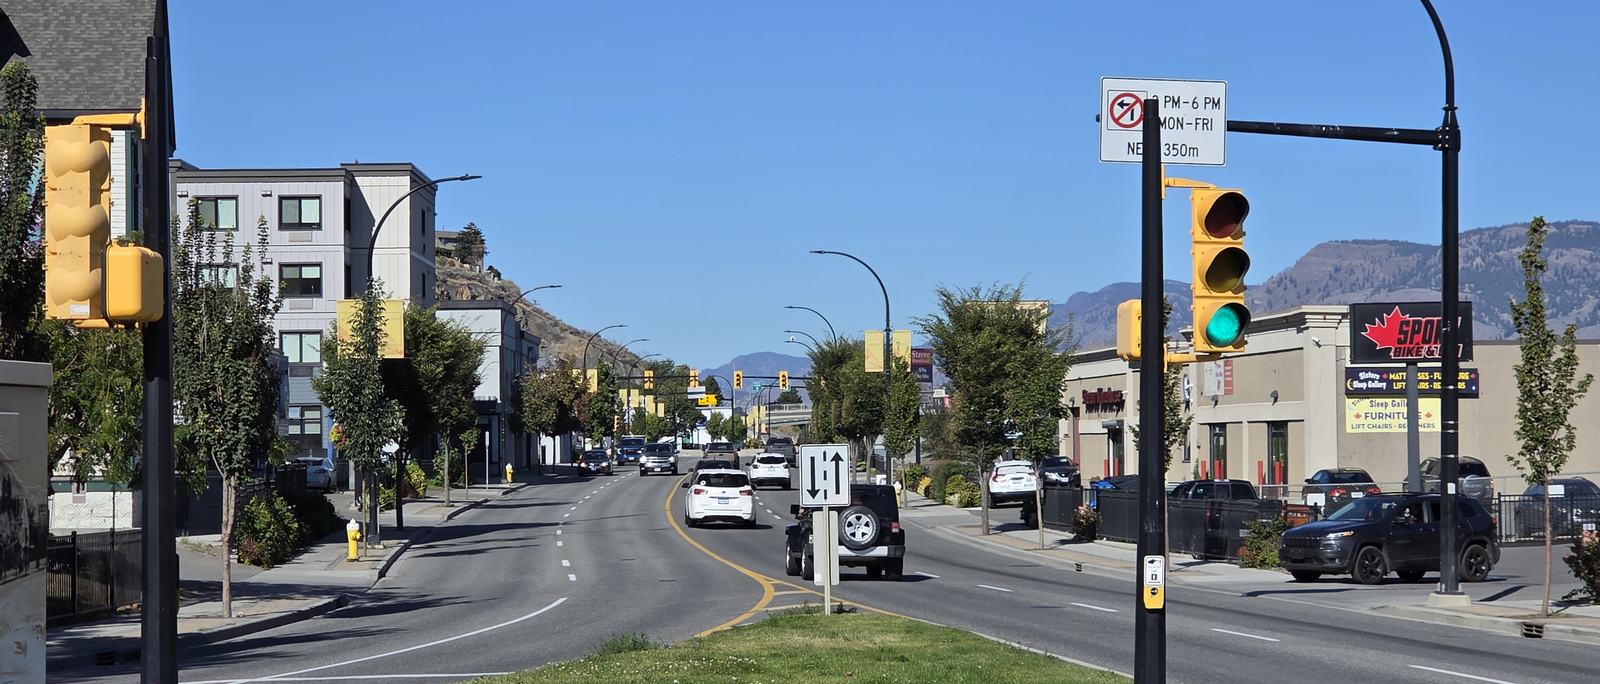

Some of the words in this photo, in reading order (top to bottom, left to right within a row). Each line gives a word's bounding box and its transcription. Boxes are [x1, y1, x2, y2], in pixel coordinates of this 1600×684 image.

[1203, 96, 1221, 111] PM
[1160, 117, 1213, 131] MON-FRI
[1127, 142, 1144, 156] NE
[1163, 143, 1199, 157] 350m
[1393, 346, 1424, 357] BIKE
[1358, 371, 1380, 380] Sisters
[1389, 372, 1429, 380] MATTSES
[1353, 380, 1367, 390] Sleep
[1368, 380, 1387, 390] Gallery
[1393, 382, 1406, 390] LIFT
[1369, 400, 1389, 410] Sleep
[1391, 400, 1408, 408] Gall
[1364, 412, 1423, 420] FURNITUE
